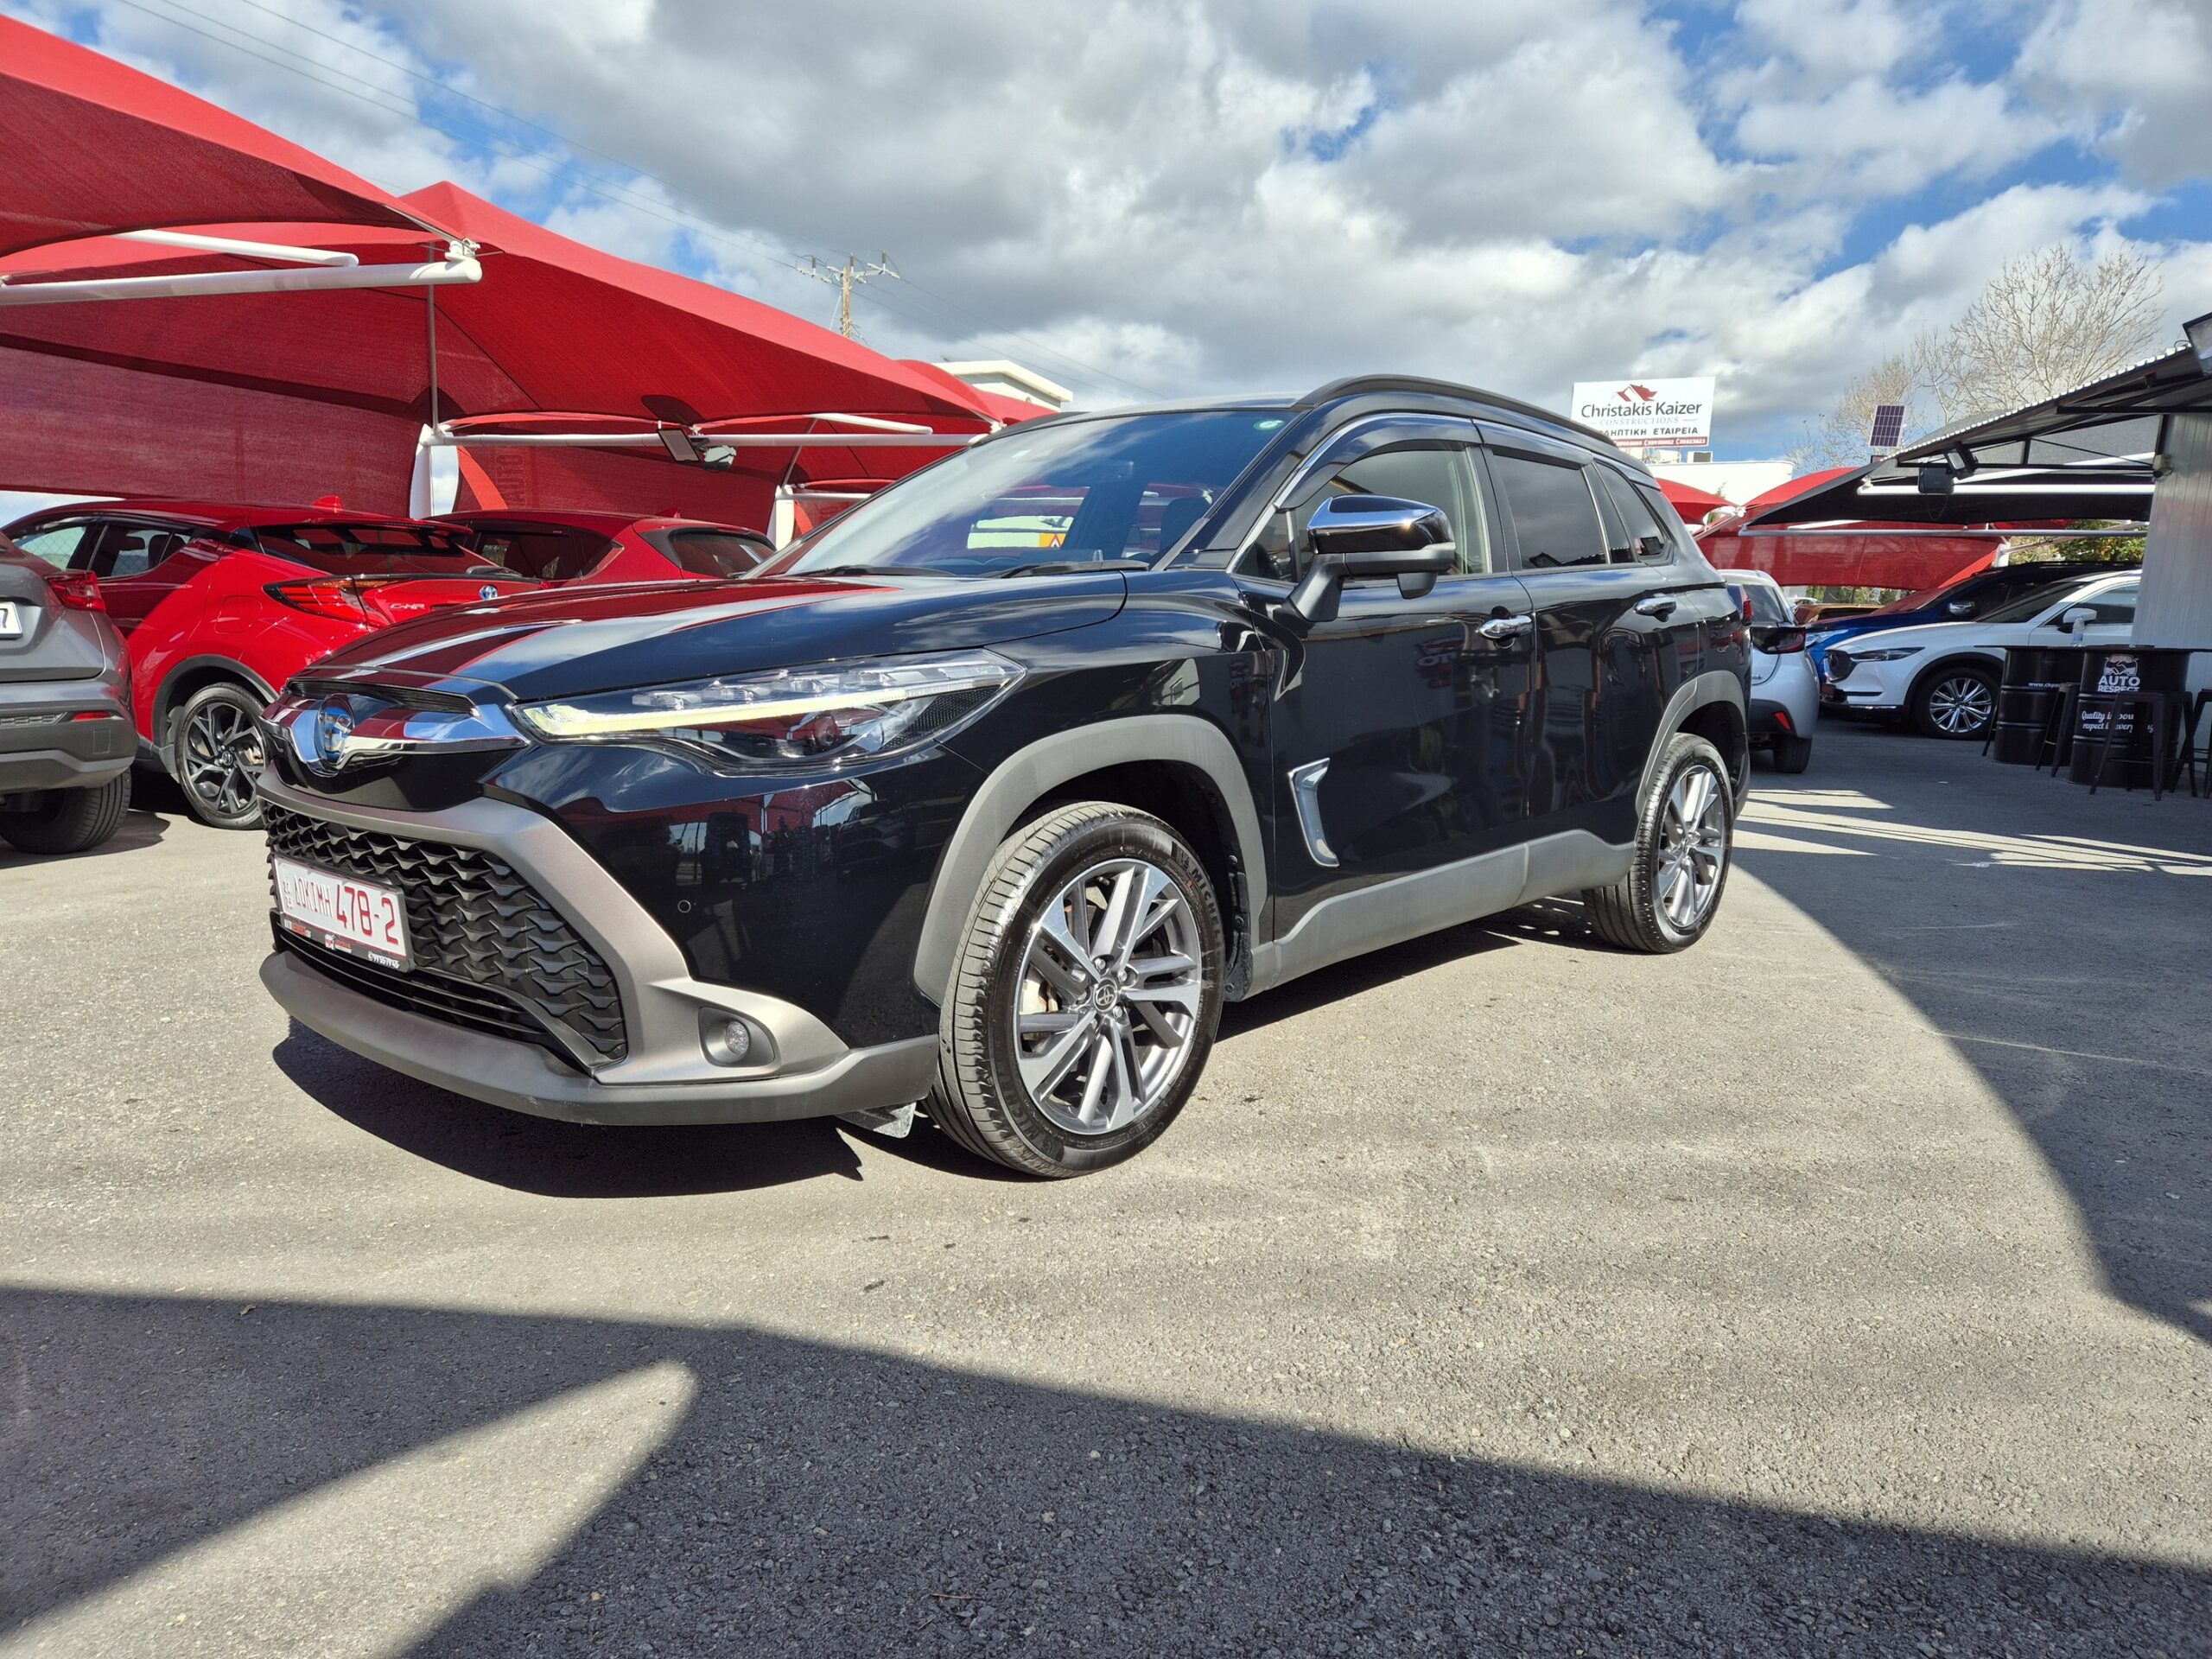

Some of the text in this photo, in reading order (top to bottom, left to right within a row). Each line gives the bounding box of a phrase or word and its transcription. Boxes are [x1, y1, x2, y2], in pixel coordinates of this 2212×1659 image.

[1581, 401, 1702, 418] Christakis Kaizer
[1599, 416, 1679, 427] CONSTRUCTIONS
[1653, 427, 1699, 435] ΕΤΑΙΡΕΙΑ
[2098, 675, 2141, 687] AUTO
[2082, 710, 2106, 723] Quality
[2082, 723, 2104, 732] respect
[336, 884, 399, 945] 478-2
